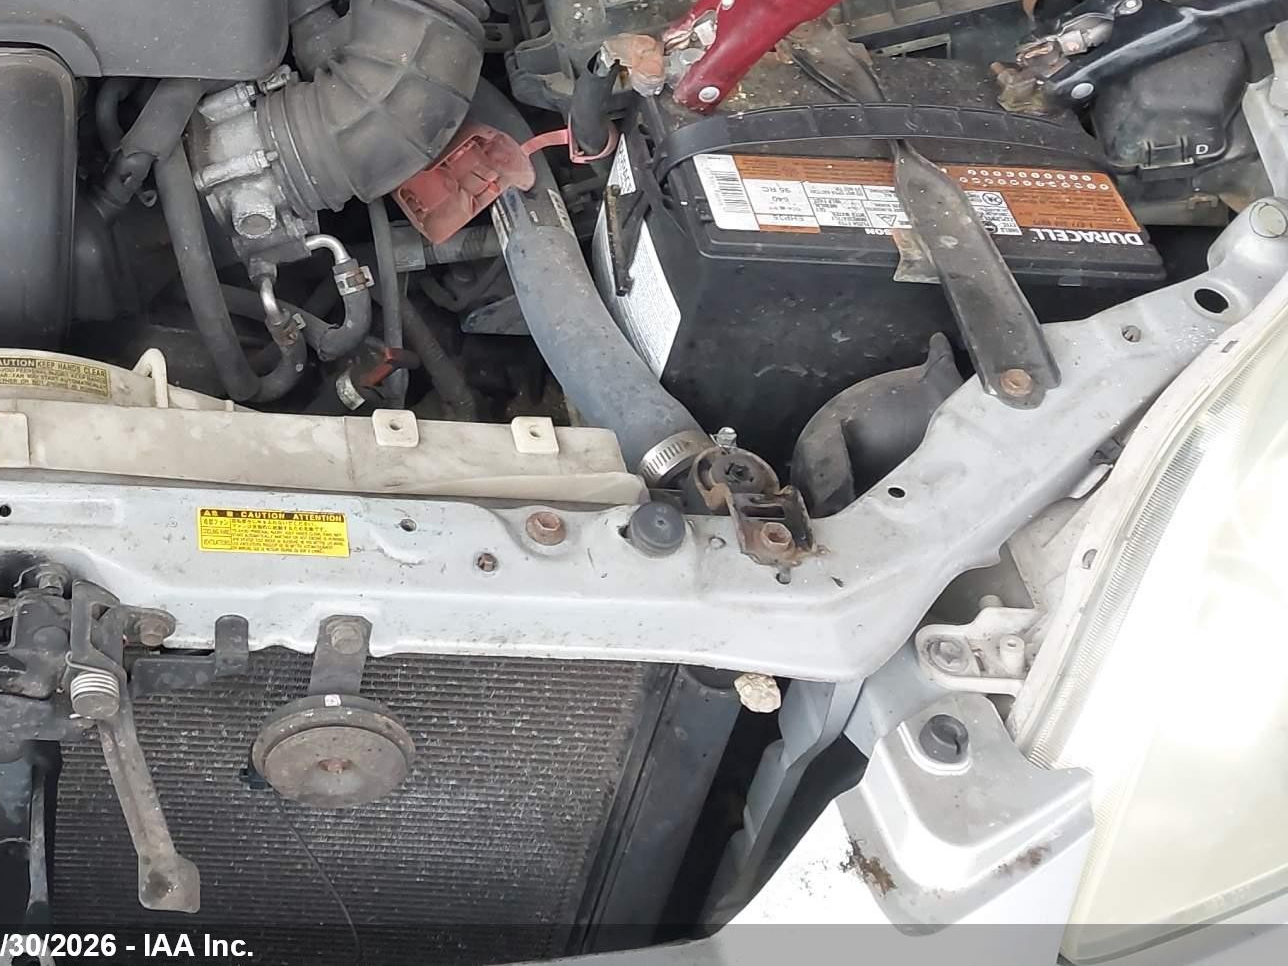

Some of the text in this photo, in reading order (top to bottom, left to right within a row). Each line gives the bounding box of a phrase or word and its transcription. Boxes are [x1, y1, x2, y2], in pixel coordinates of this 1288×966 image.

[1029, 228, 1144, 246] DURACELL
[37, 360, 55, 369] KEEP
[83, 366, 106, 377] CLEAR
[240, 511, 285, 520] CAUTION
[292, 513, 343, 523] ATTENTION
